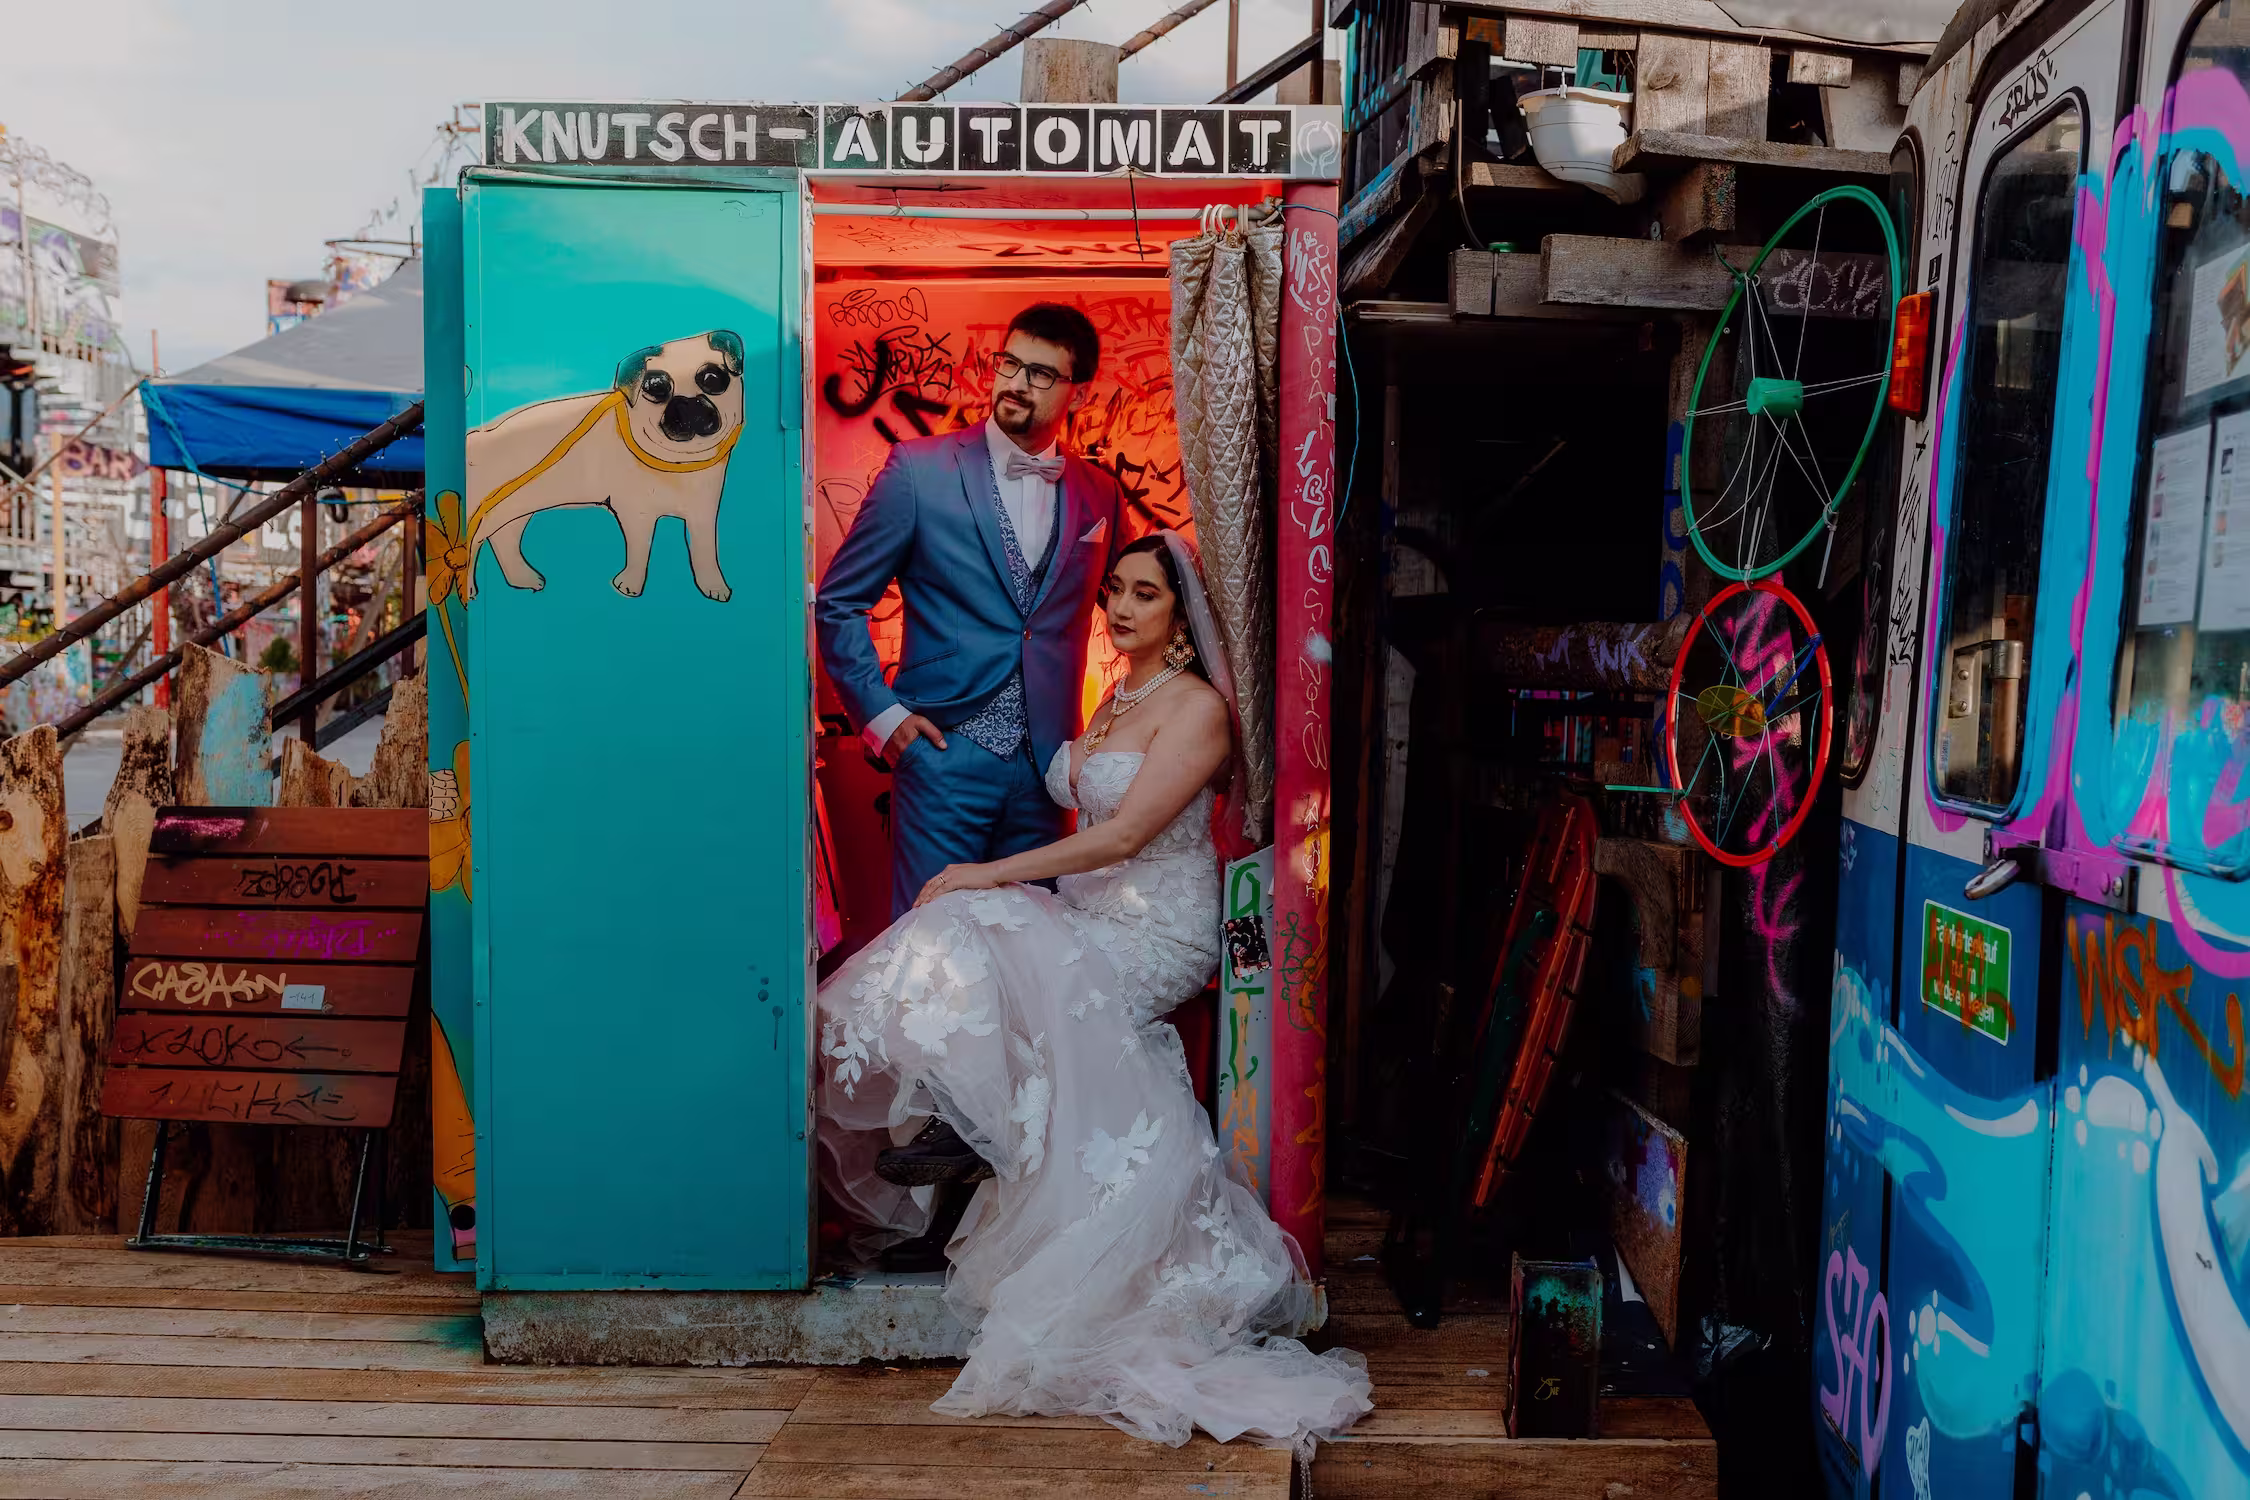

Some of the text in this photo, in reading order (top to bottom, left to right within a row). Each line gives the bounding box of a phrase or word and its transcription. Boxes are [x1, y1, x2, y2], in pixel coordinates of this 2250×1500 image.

[501, 107, 1282, 168] KNUTSCH- AUTOMAT
[61, 439, 132, 481] BAR
